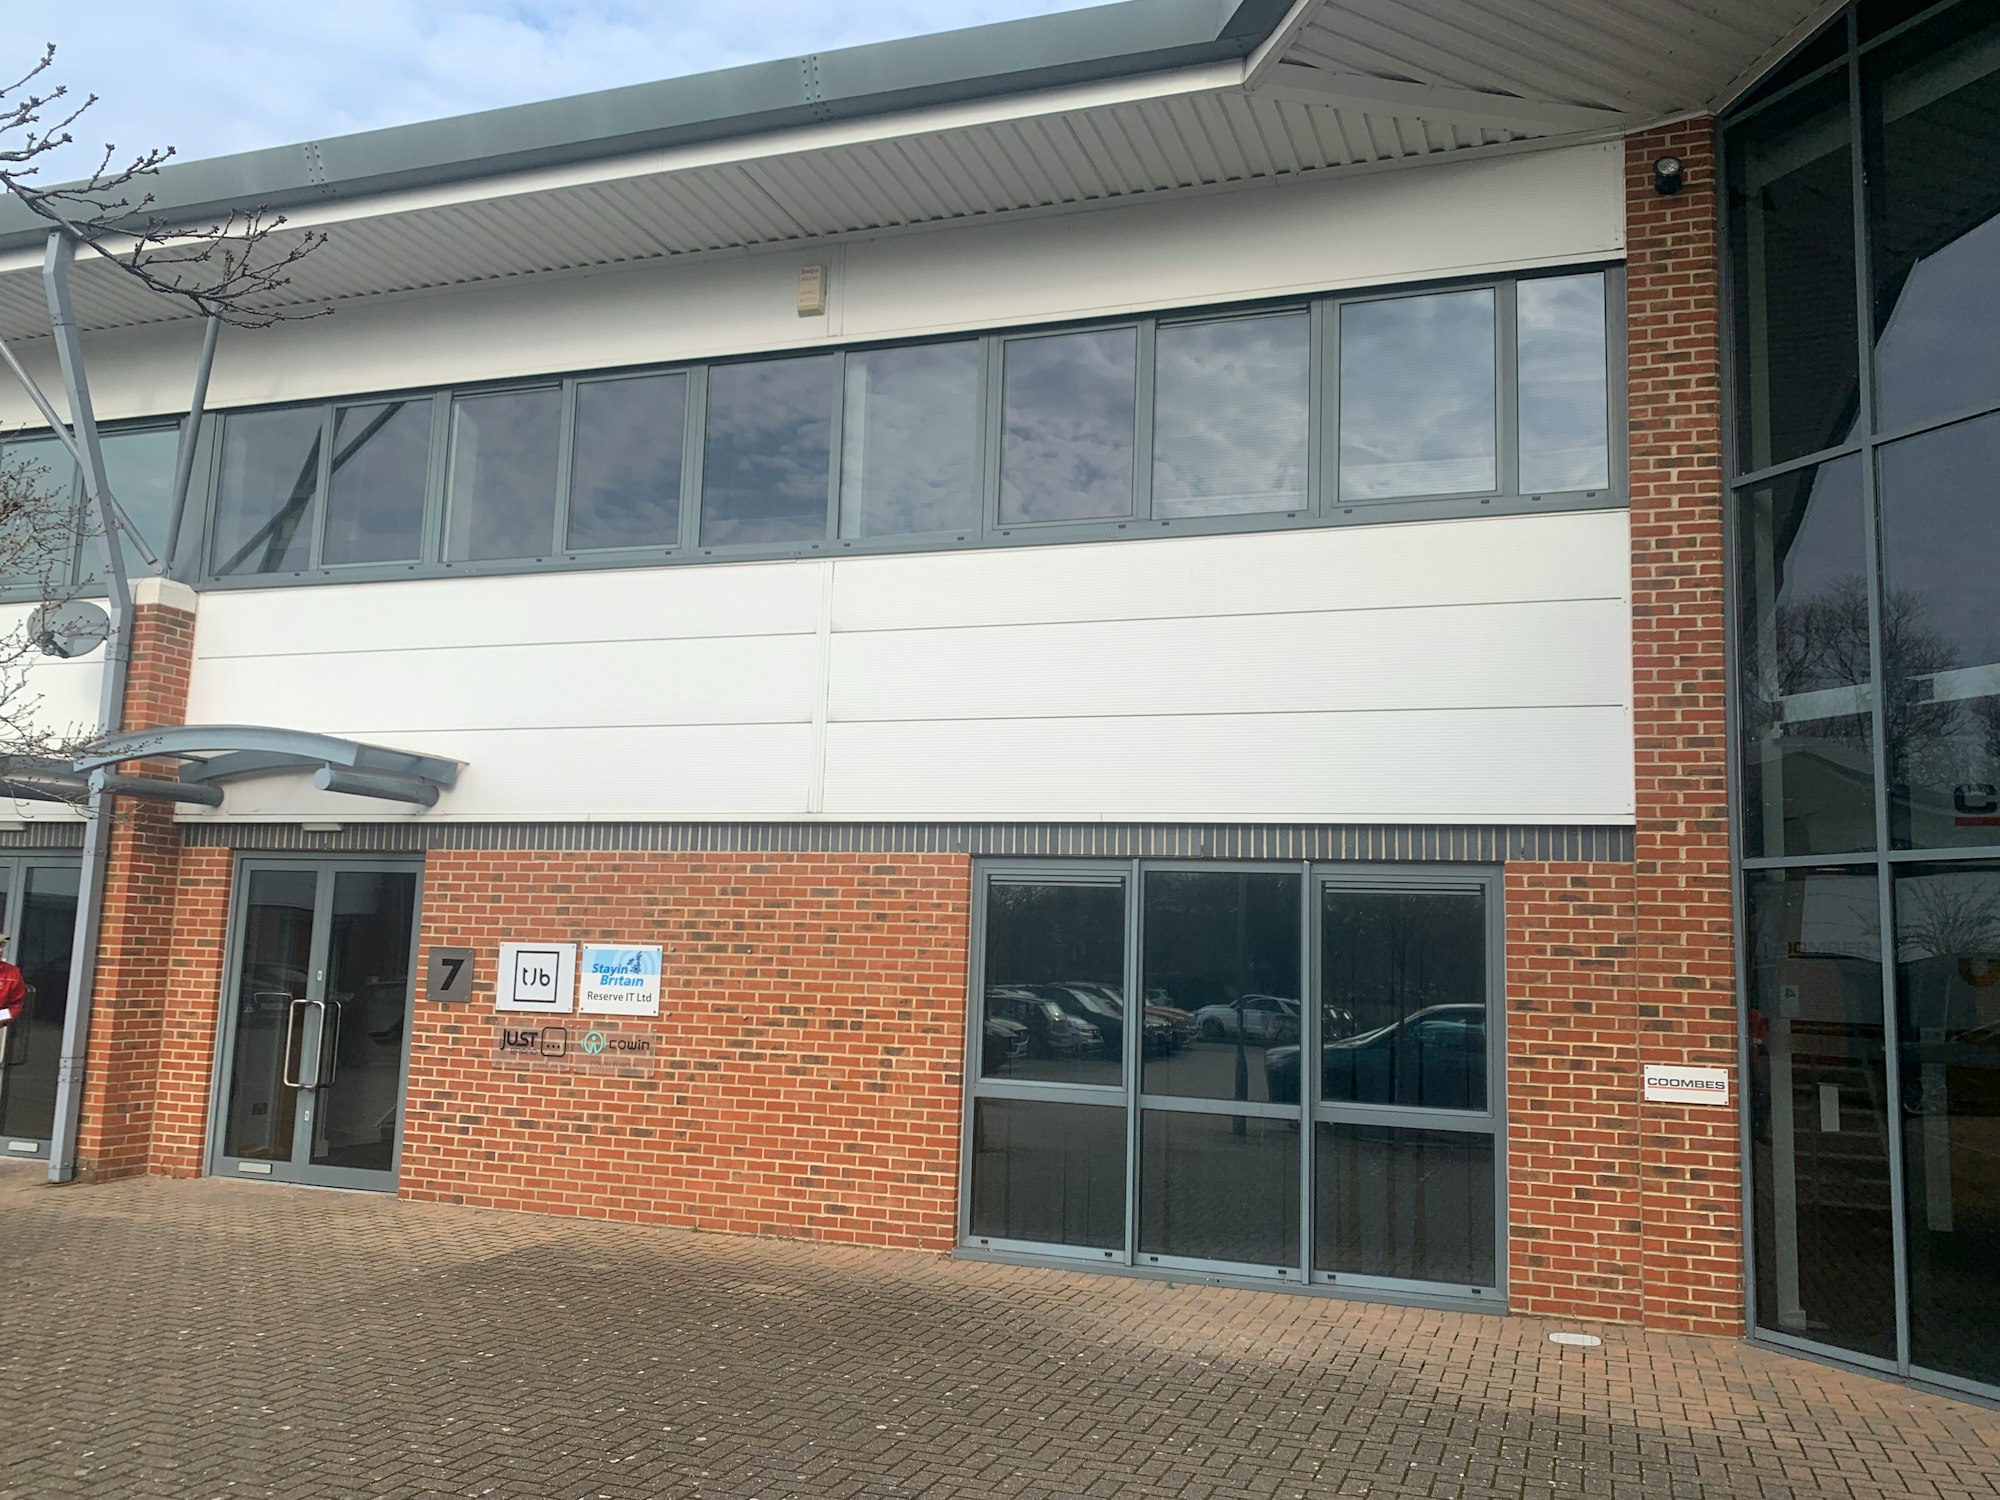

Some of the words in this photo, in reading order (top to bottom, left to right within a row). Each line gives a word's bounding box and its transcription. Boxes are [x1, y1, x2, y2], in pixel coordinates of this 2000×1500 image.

[440, 958, 466, 991] 7
[592, 963, 628, 977] Stayin
[600, 974, 644, 987] Britain
[587, 990, 624, 1002] Reserve
[625, 992, 635, 1002] IT
[636, 993, 652, 1003] Ltd
[499, 1028, 538, 1051] JUST
[608, 1039, 650, 1051] cowin
[1647, 1077, 1726, 1090] COOMBES
